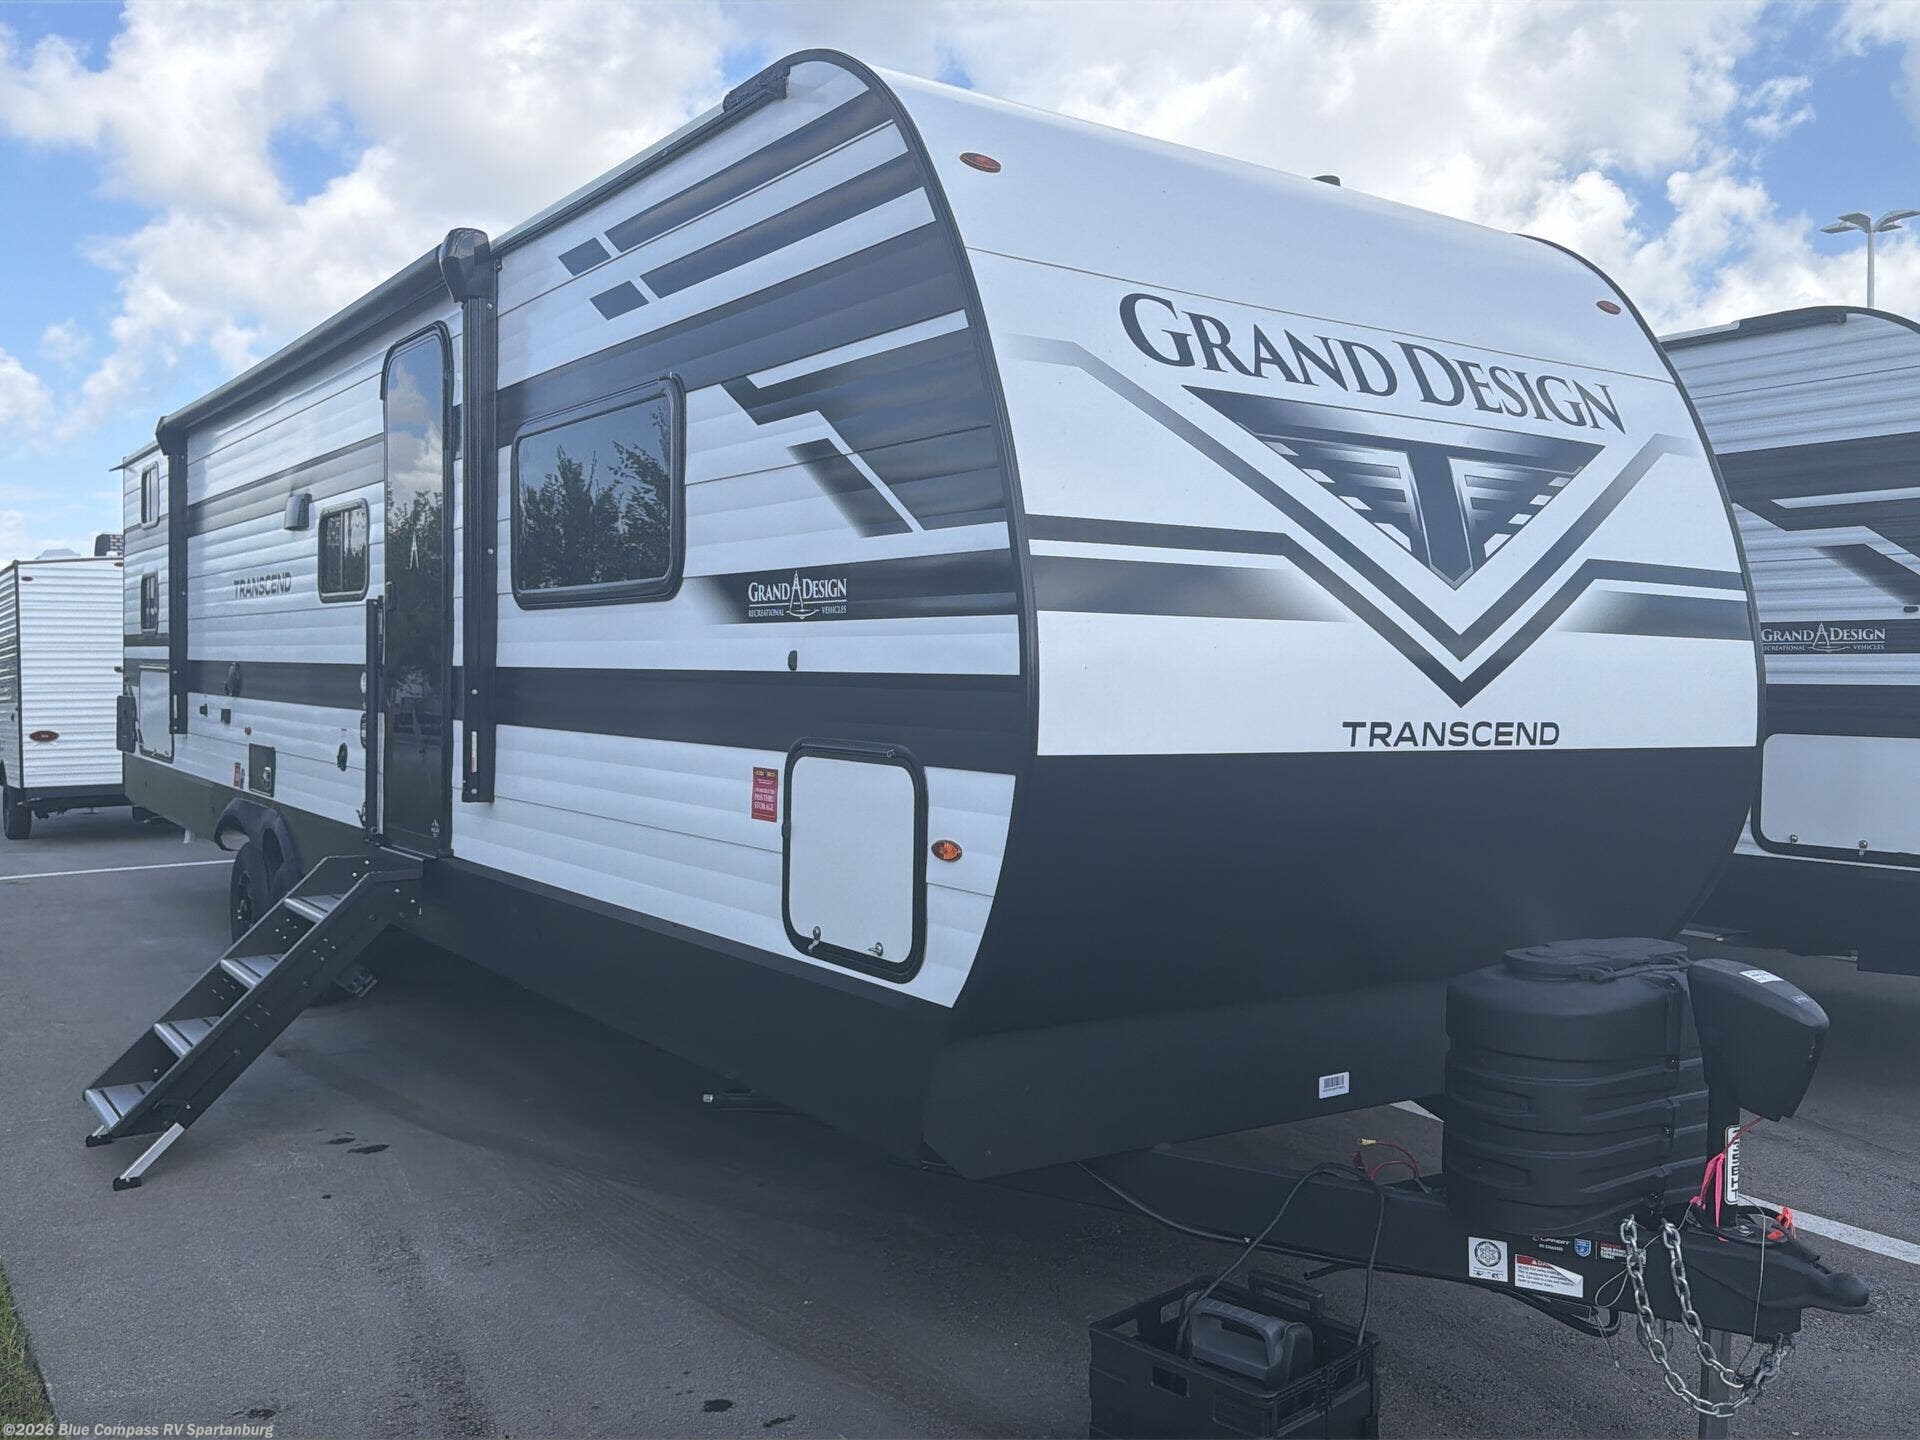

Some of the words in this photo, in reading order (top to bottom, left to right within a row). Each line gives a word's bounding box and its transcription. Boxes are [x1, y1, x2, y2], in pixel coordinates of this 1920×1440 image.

[1119, 292, 1398, 398] GRAND
[1393, 340, 1626, 434] DESIGN
[233, 571, 292, 599] TRANSCEND
[748, 582, 791, 602] GRAND
[802, 579, 847, 599] DESIGN
[748, 608, 785, 618] RECREATIONAL
[821, 605, 847, 615] VEHICLES
[1761, 628, 1815, 642] GRAND
[1829, 627, 1886, 641] DESIGN
[1342, 721, 1560, 747] TRANSCEND
